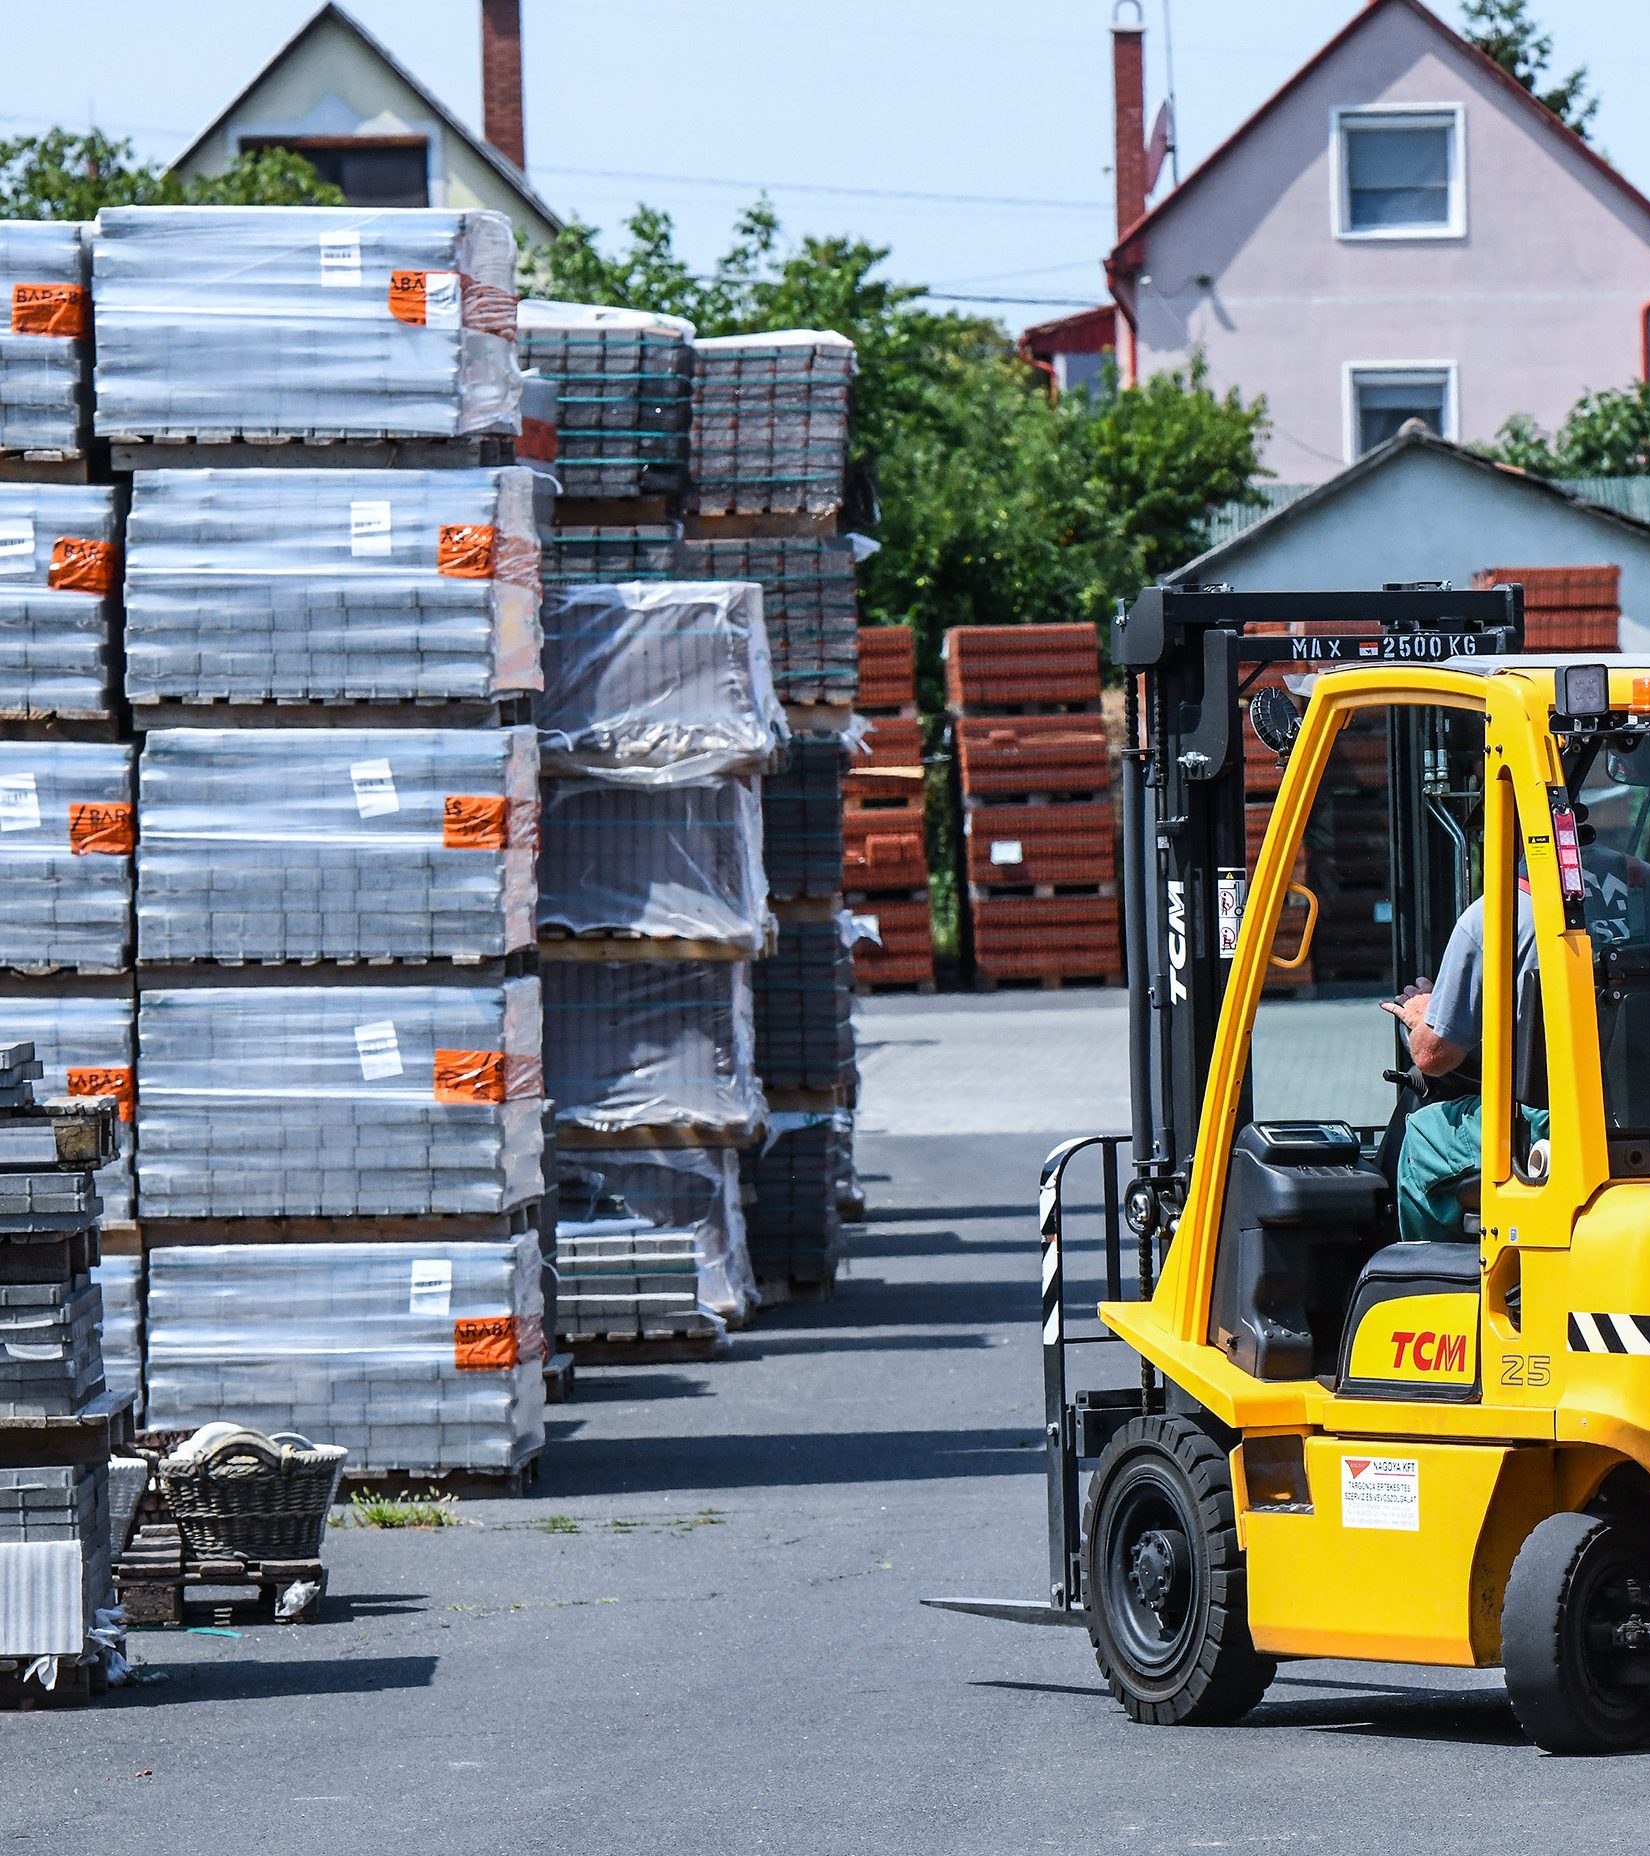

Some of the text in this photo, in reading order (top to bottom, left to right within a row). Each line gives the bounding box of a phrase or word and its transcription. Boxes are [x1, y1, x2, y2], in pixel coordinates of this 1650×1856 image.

[1292, 635, 1476, 660] MAX 2500 KG
[1167, 880, 1188, 1006] TCM
[1391, 1331, 1467, 1372] TCM
[1500, 1354, 1551, 1387] 25
[1373, 1461, 1402, 1472] NAGOYA
